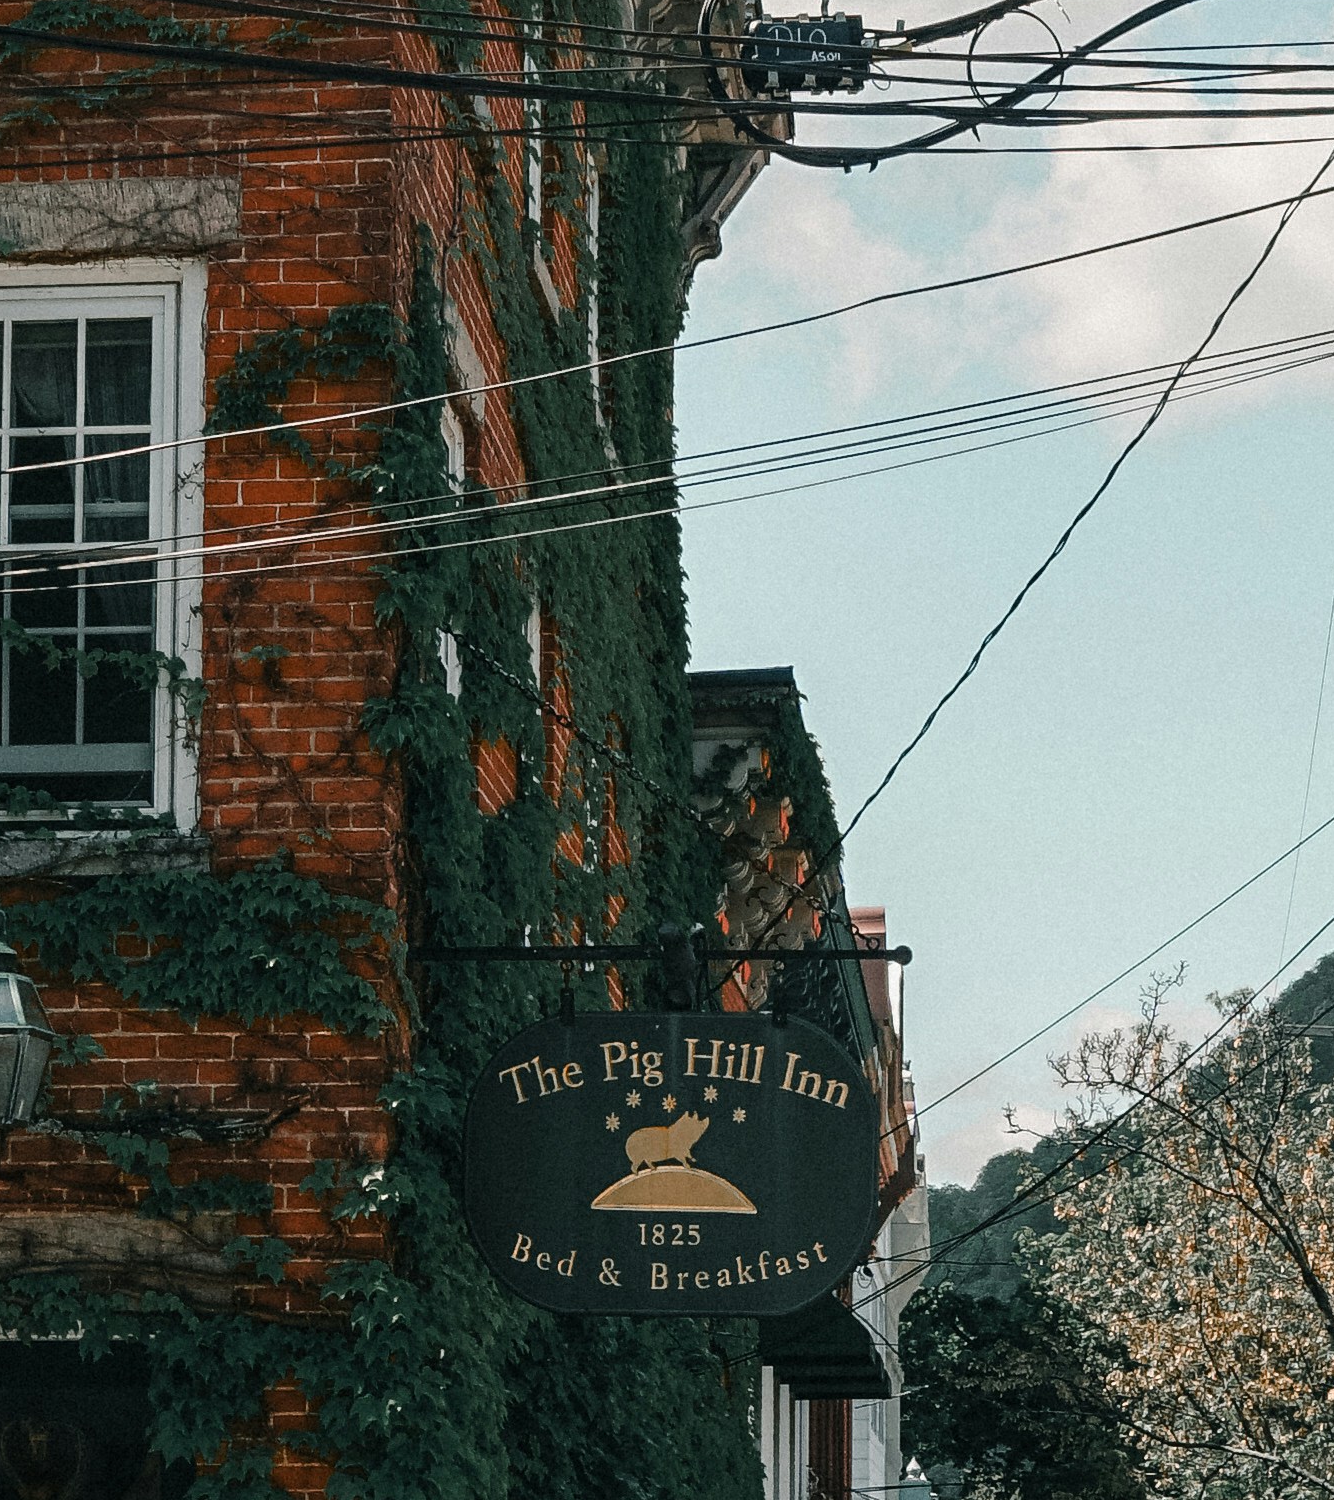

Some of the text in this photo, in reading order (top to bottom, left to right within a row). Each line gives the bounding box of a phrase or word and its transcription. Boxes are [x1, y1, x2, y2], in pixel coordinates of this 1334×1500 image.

[499, 1037, 851, 1110] The Pig Hill Inn
[510, 1233, 829, 1291] Bed & Breakfast
[638, 1223, 701, 1247] 1825
